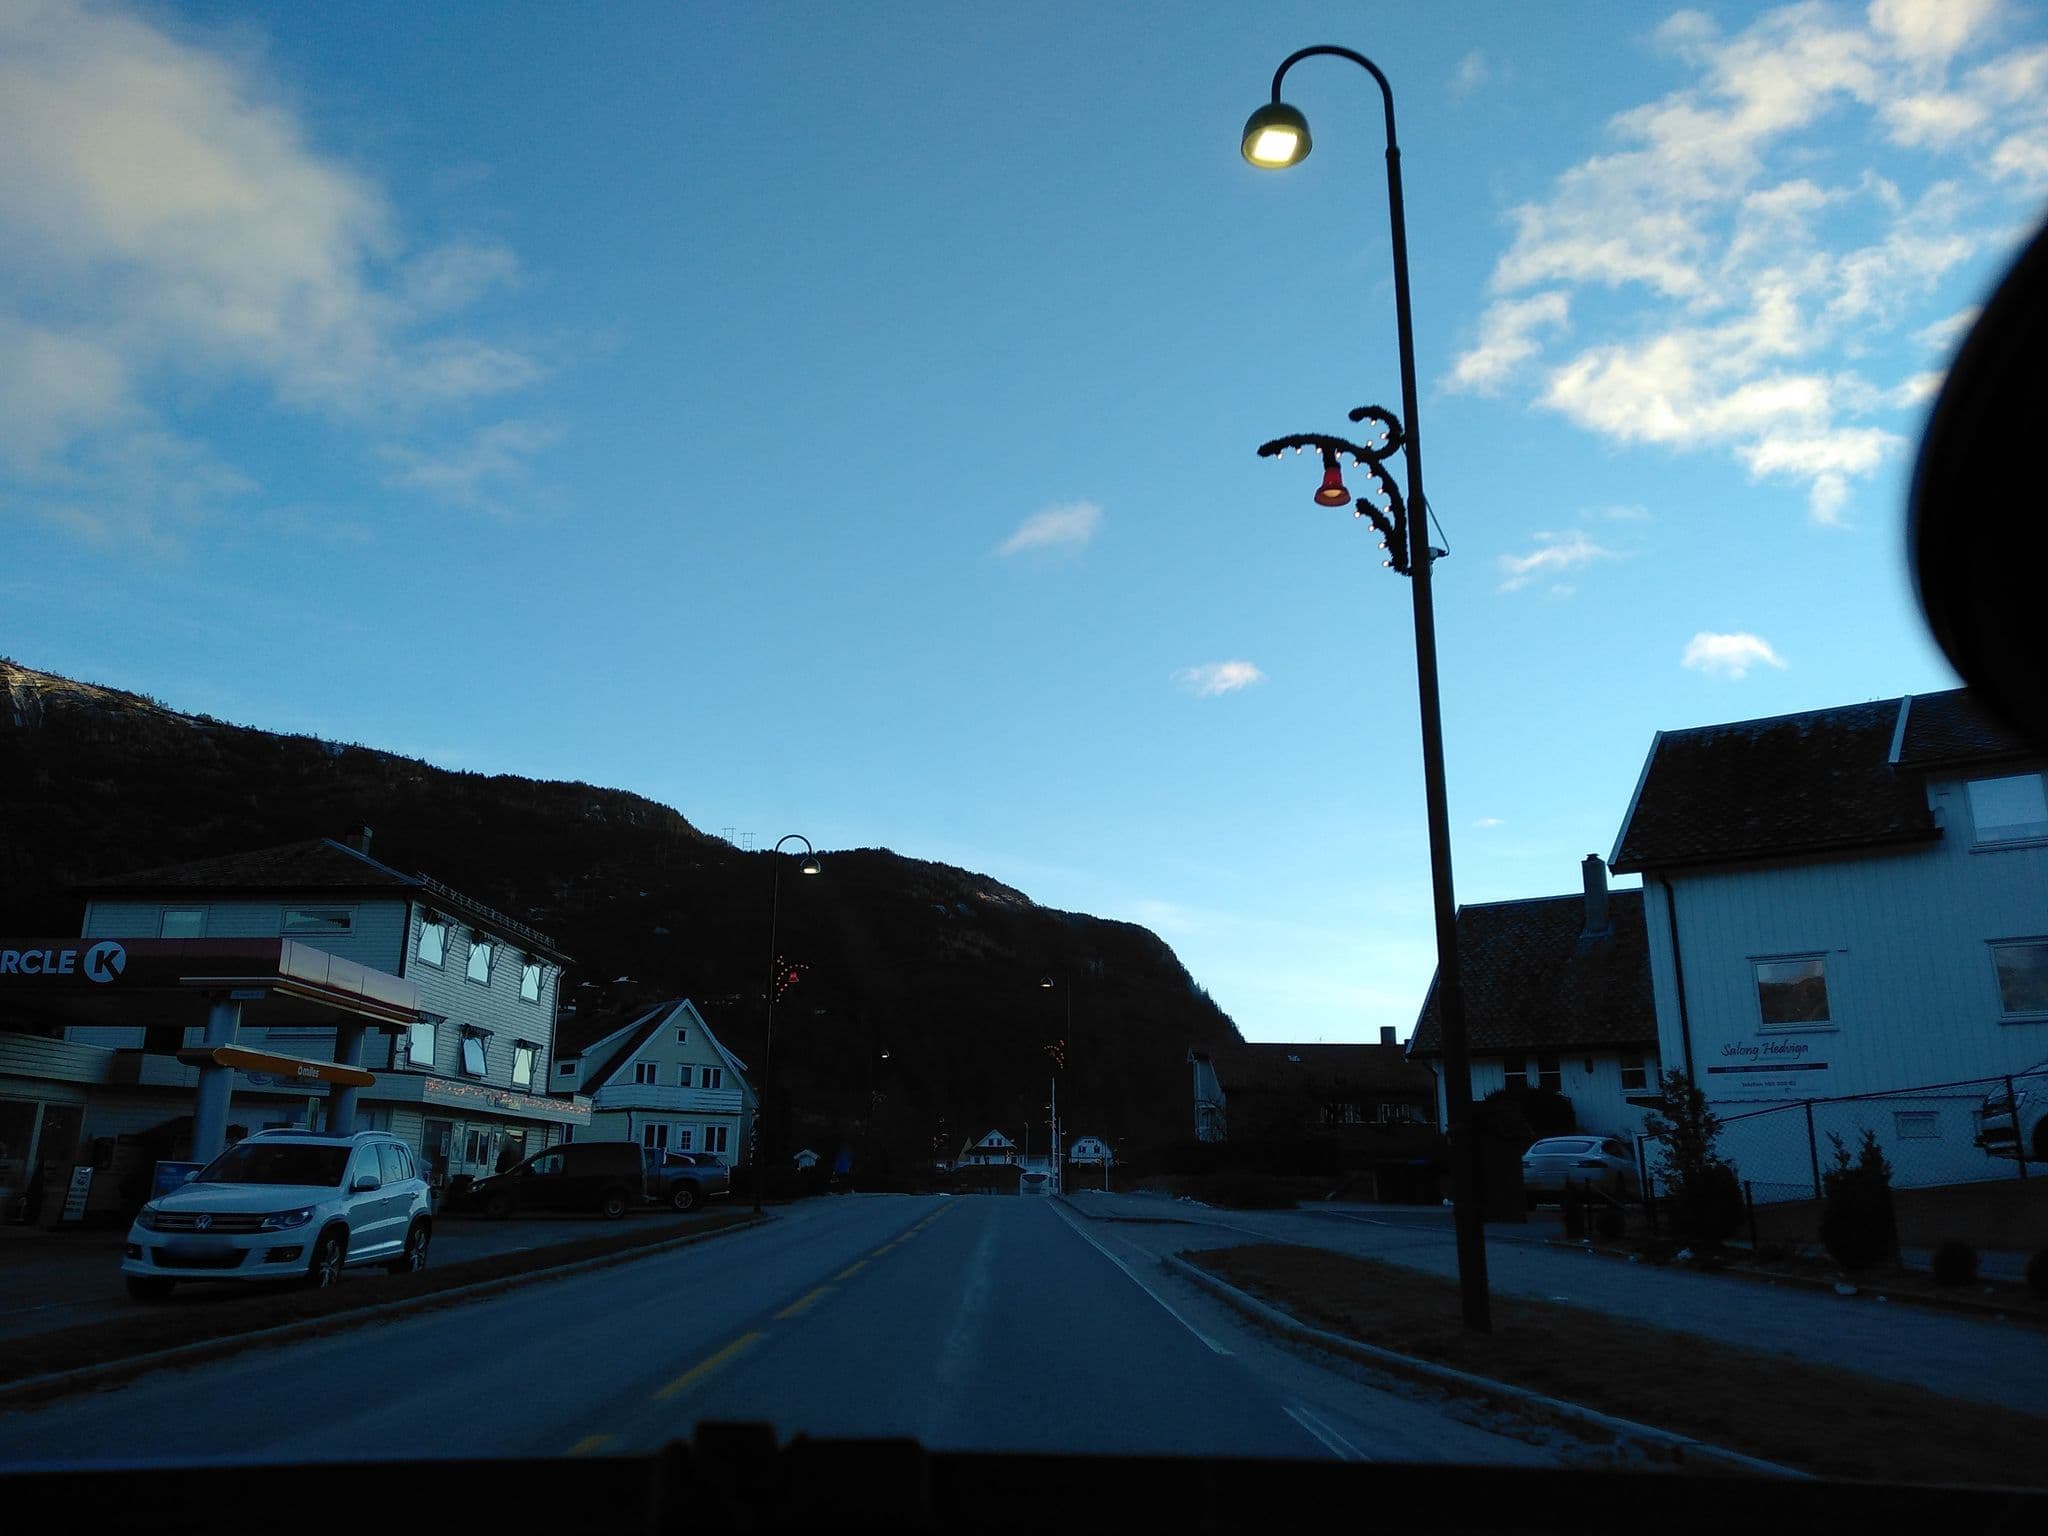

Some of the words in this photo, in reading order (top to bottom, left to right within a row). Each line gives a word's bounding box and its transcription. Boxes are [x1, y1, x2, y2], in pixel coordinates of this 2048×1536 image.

[0, 950, 77, 974] RCLE
[91, 948, 123, 981] K
[1721, 1041, 1759, 1061] Salong
